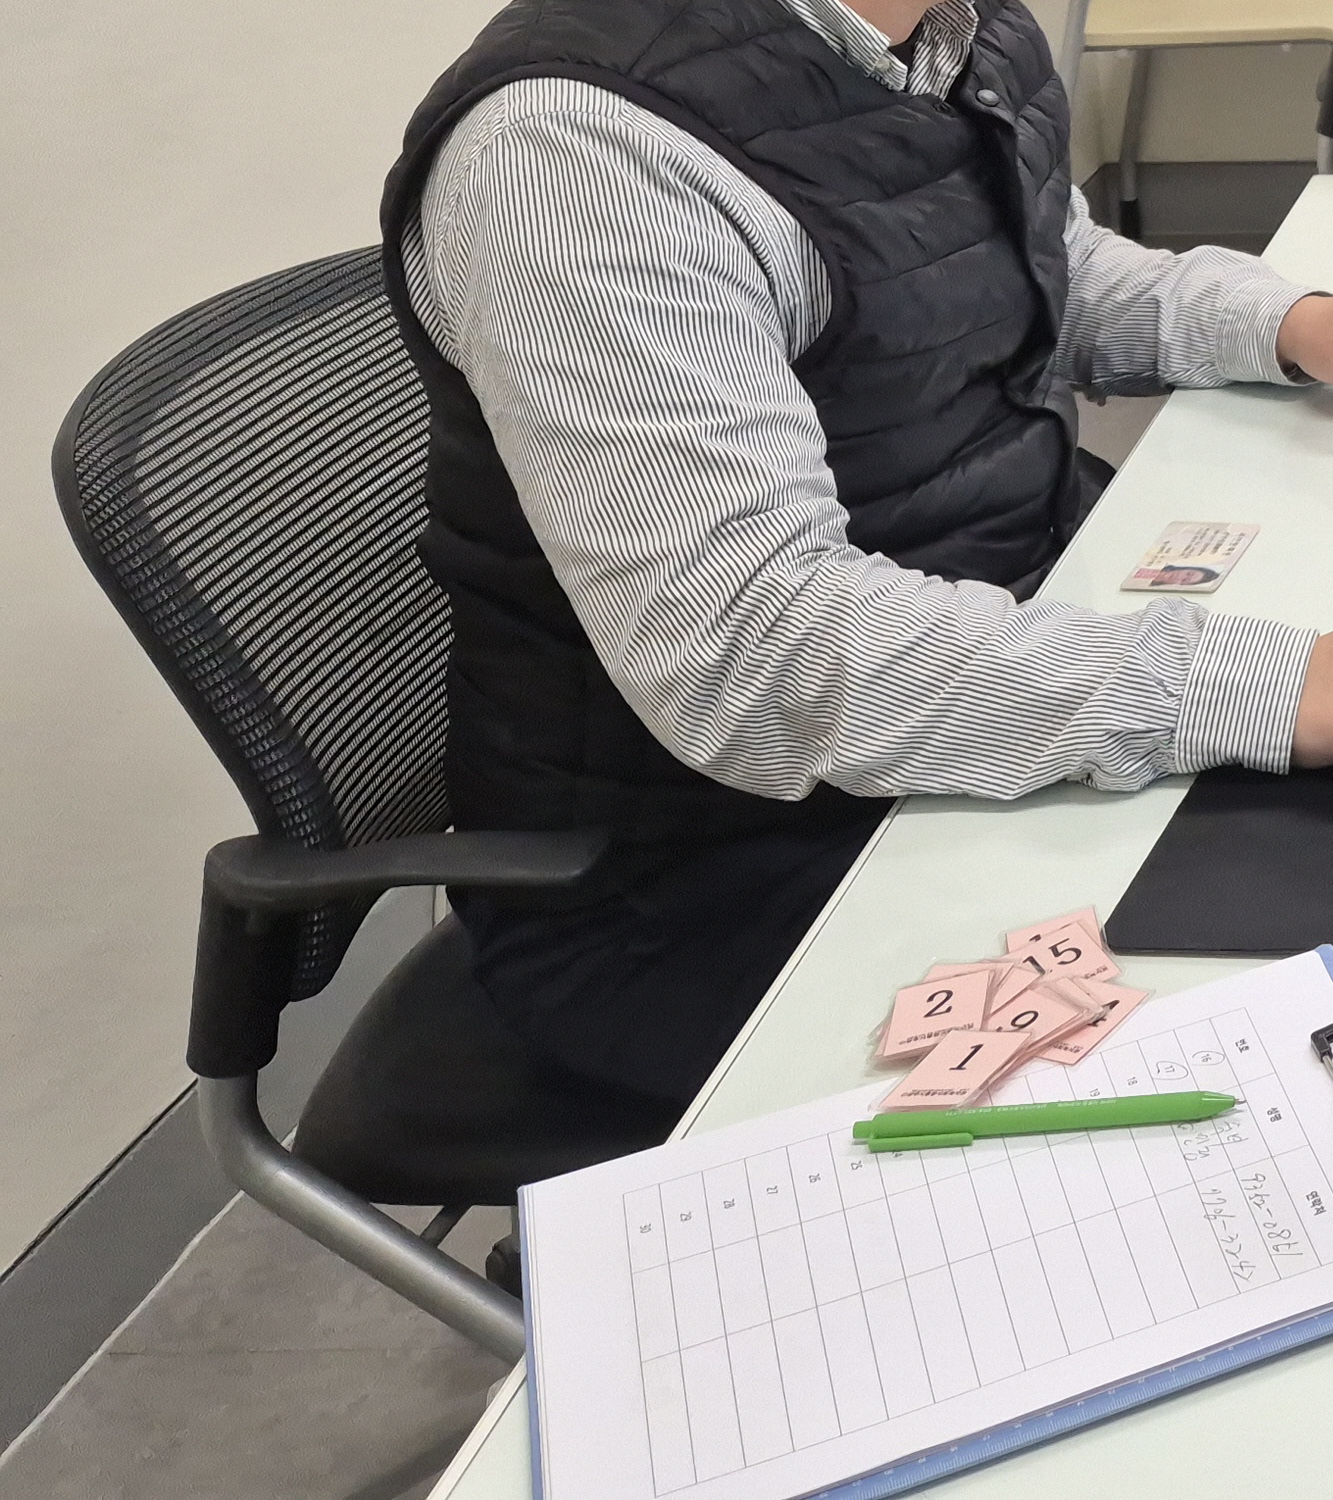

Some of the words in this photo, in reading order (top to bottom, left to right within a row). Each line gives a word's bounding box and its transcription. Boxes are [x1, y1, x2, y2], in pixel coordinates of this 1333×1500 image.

[1022, 938, 1082, 975] 15
[923, 989, 954, 1018] 2
[949, 1043, 984, 1071] 1
[1200, 1053, 1212, 1063] 16
[1164, 1065, 1176, 1074] 17
[1127, 1076, 1138, 1086] 18
[1266, 1107, 1282, 1122] 성명
